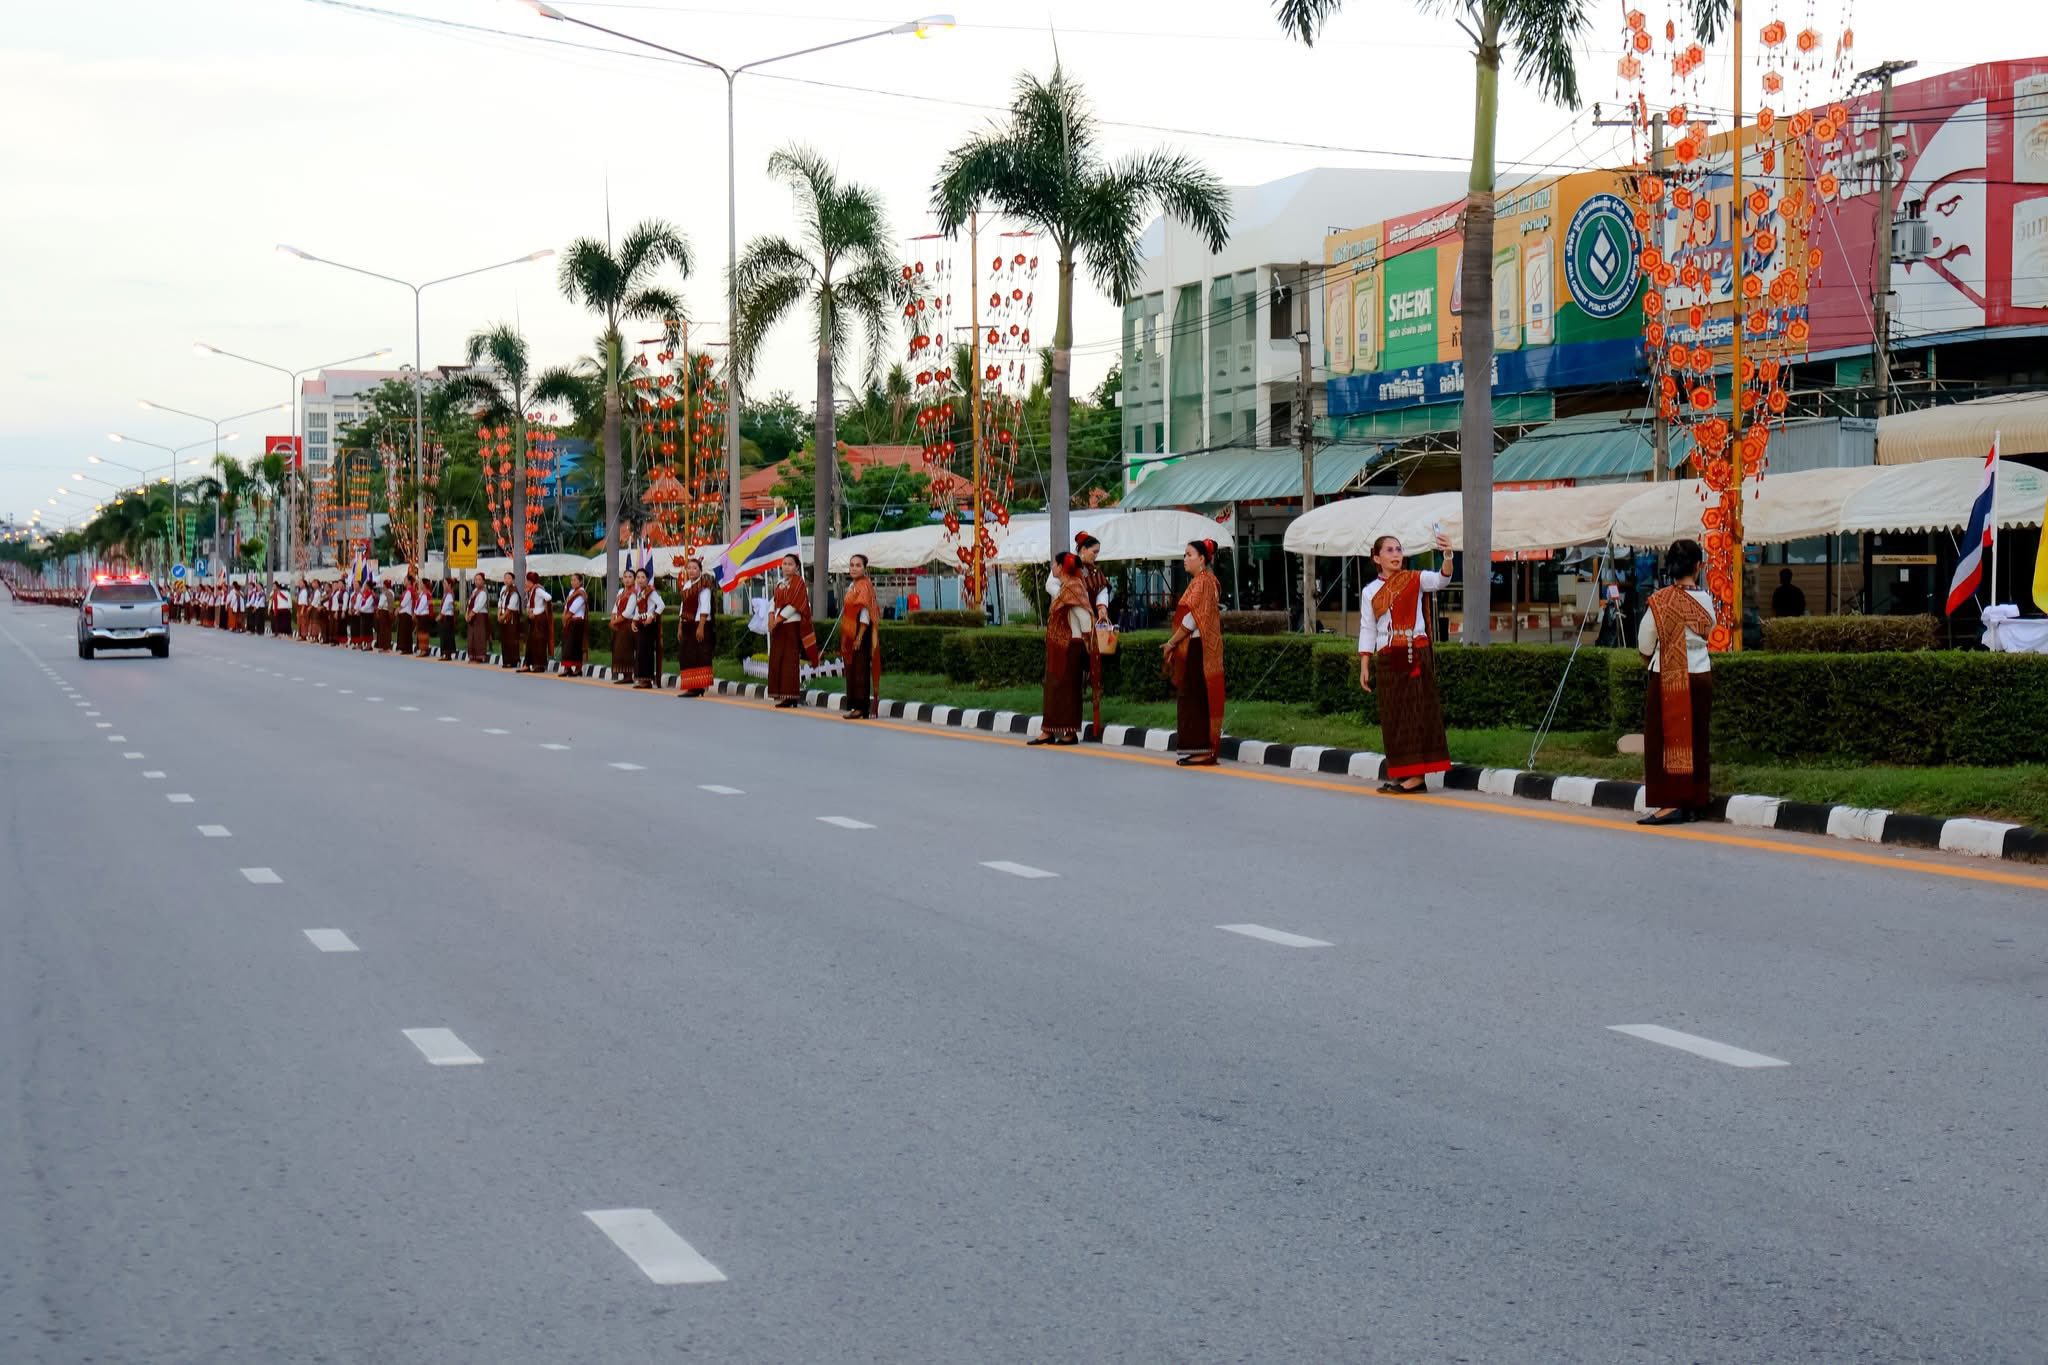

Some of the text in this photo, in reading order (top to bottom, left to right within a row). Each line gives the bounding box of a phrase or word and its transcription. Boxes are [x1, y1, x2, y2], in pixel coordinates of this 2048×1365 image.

[1389, 287, 1432, 322] SHERA
[1571, 279, 1588, 305] CEMENT
[1588, 301, 1607, 312] PUBLIC
